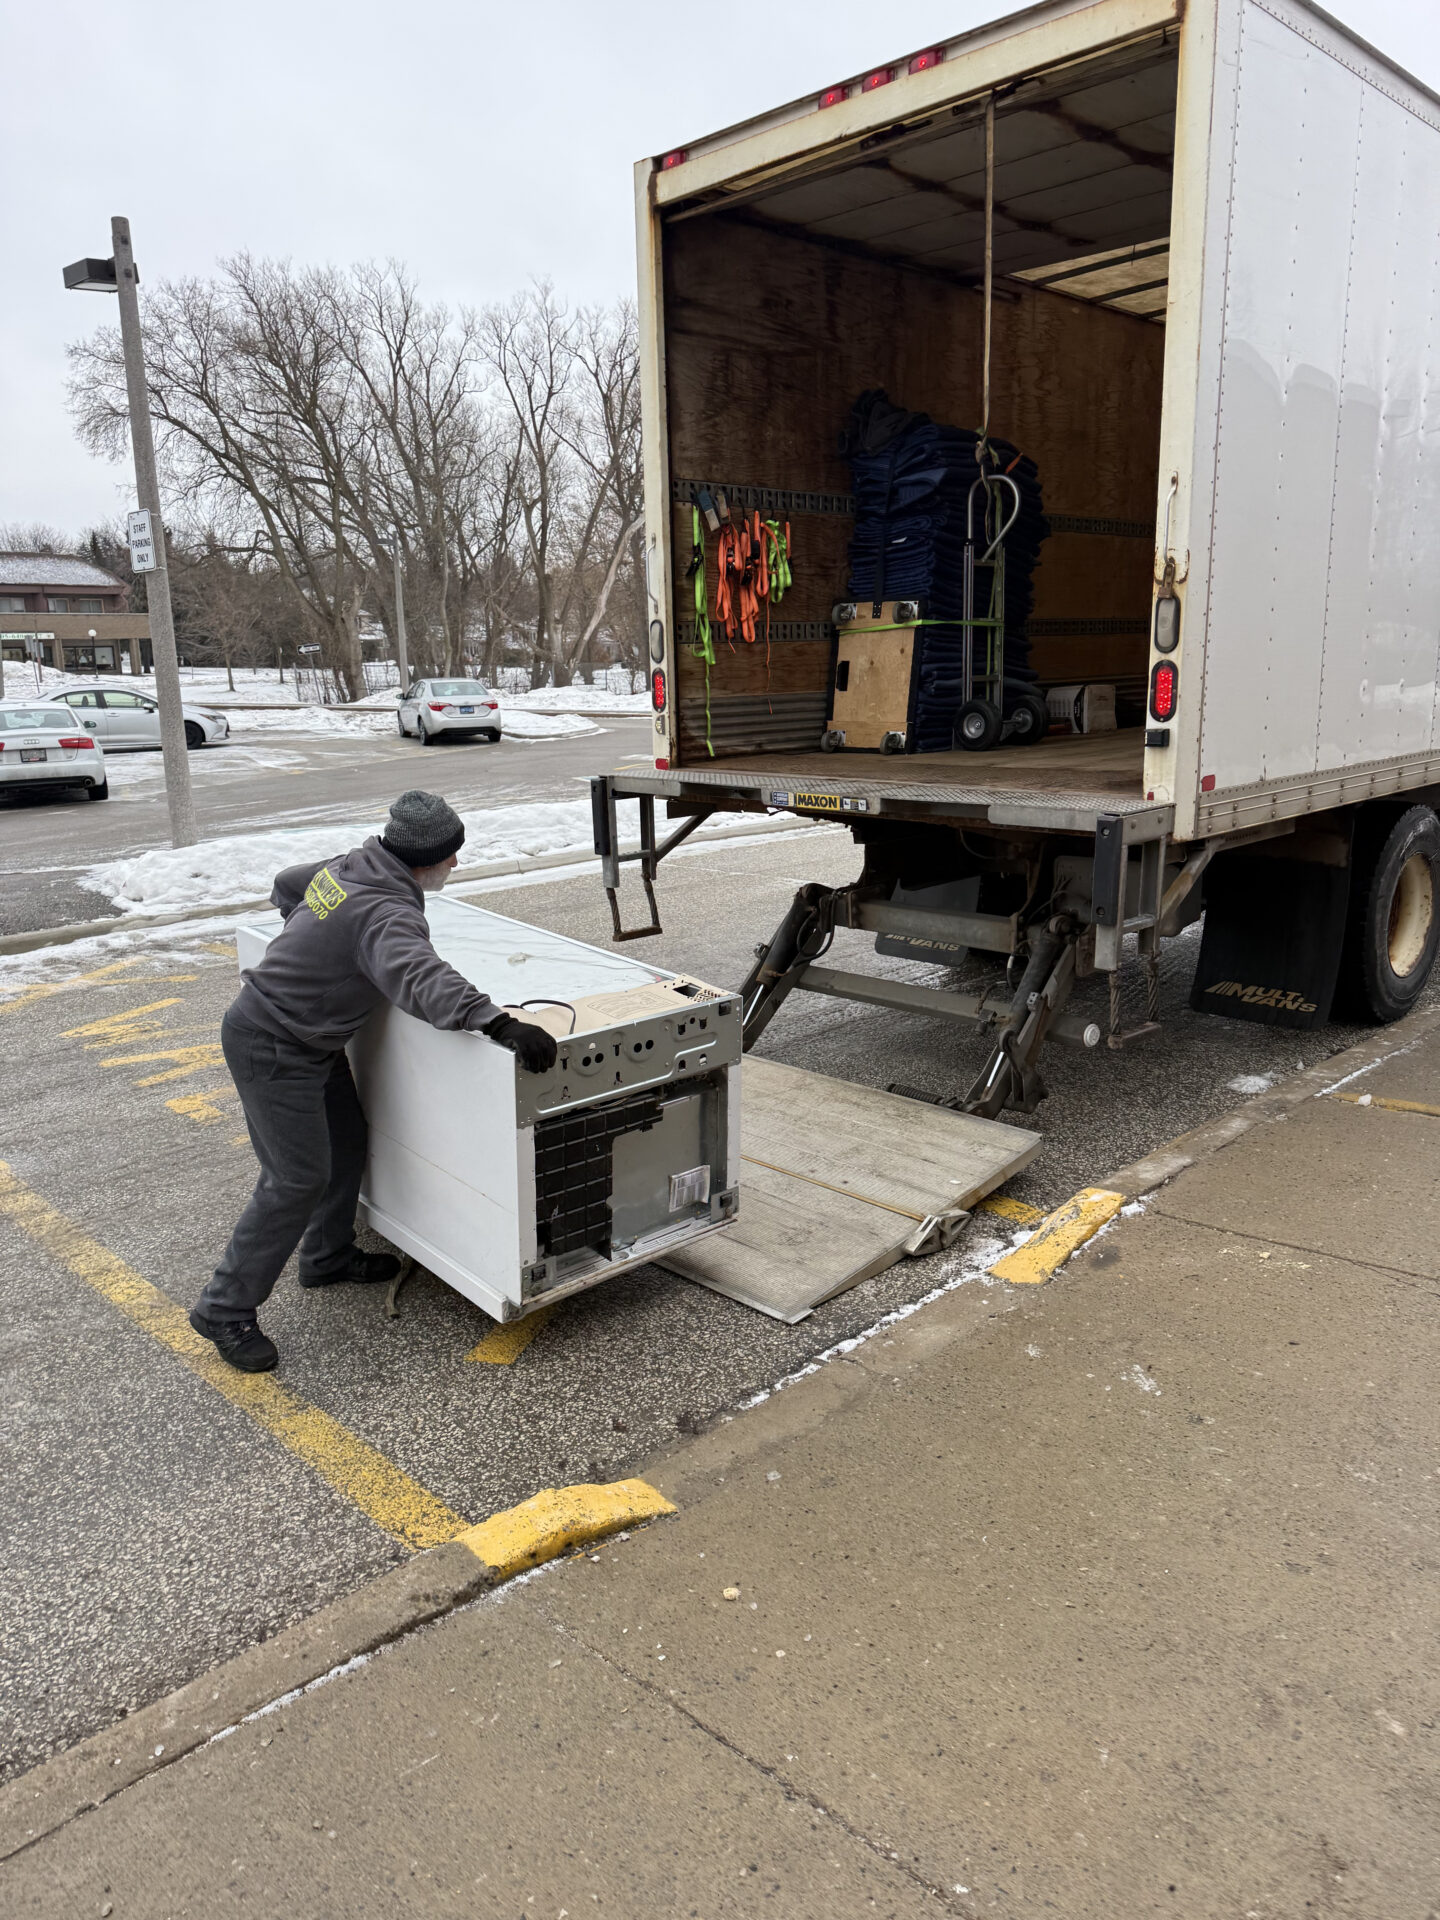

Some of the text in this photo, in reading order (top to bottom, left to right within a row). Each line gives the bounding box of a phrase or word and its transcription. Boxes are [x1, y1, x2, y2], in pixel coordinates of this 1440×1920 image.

[133, 523, 146, 534] STAFF
[132, 537, 151, 549] PARKING
[137, 553, 149, 563] ONLY
[797, 793, 837, 809] MAXON
[909, 937, 960, 951] VANS
[1241, 994, 1319, 1012] VANS
